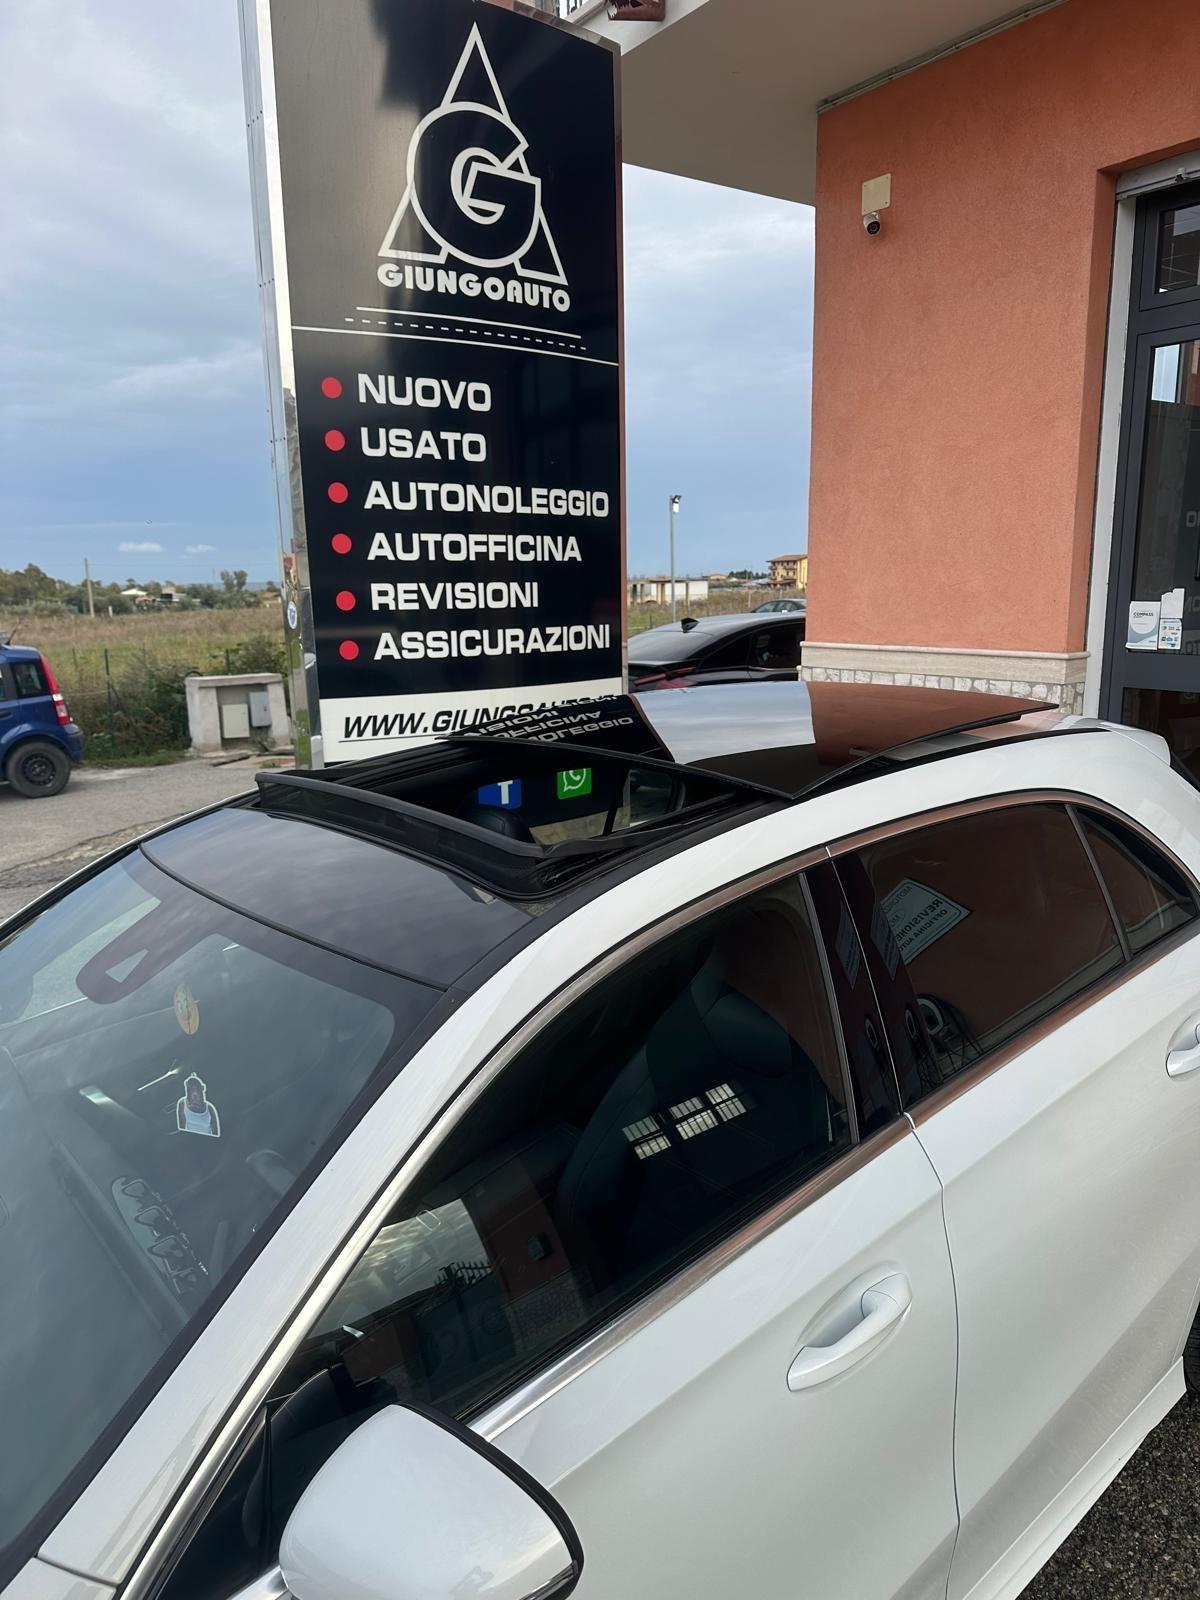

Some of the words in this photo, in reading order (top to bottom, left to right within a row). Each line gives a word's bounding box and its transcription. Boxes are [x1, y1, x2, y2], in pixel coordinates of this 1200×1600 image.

[376, 263, 571, 312] GIUNGOAUTO
[357, 373, 492, 412] NUOVO
[360, 426, 487, 462] USATO
[363, 480, 609, 517] AUTONOLEGGIO
[367, 532, 582, 561] AUTOFFICINA
[370, 581, 539, 611] REVISIONI
[373, 624, 610, 660] ASSICURAZIONI
